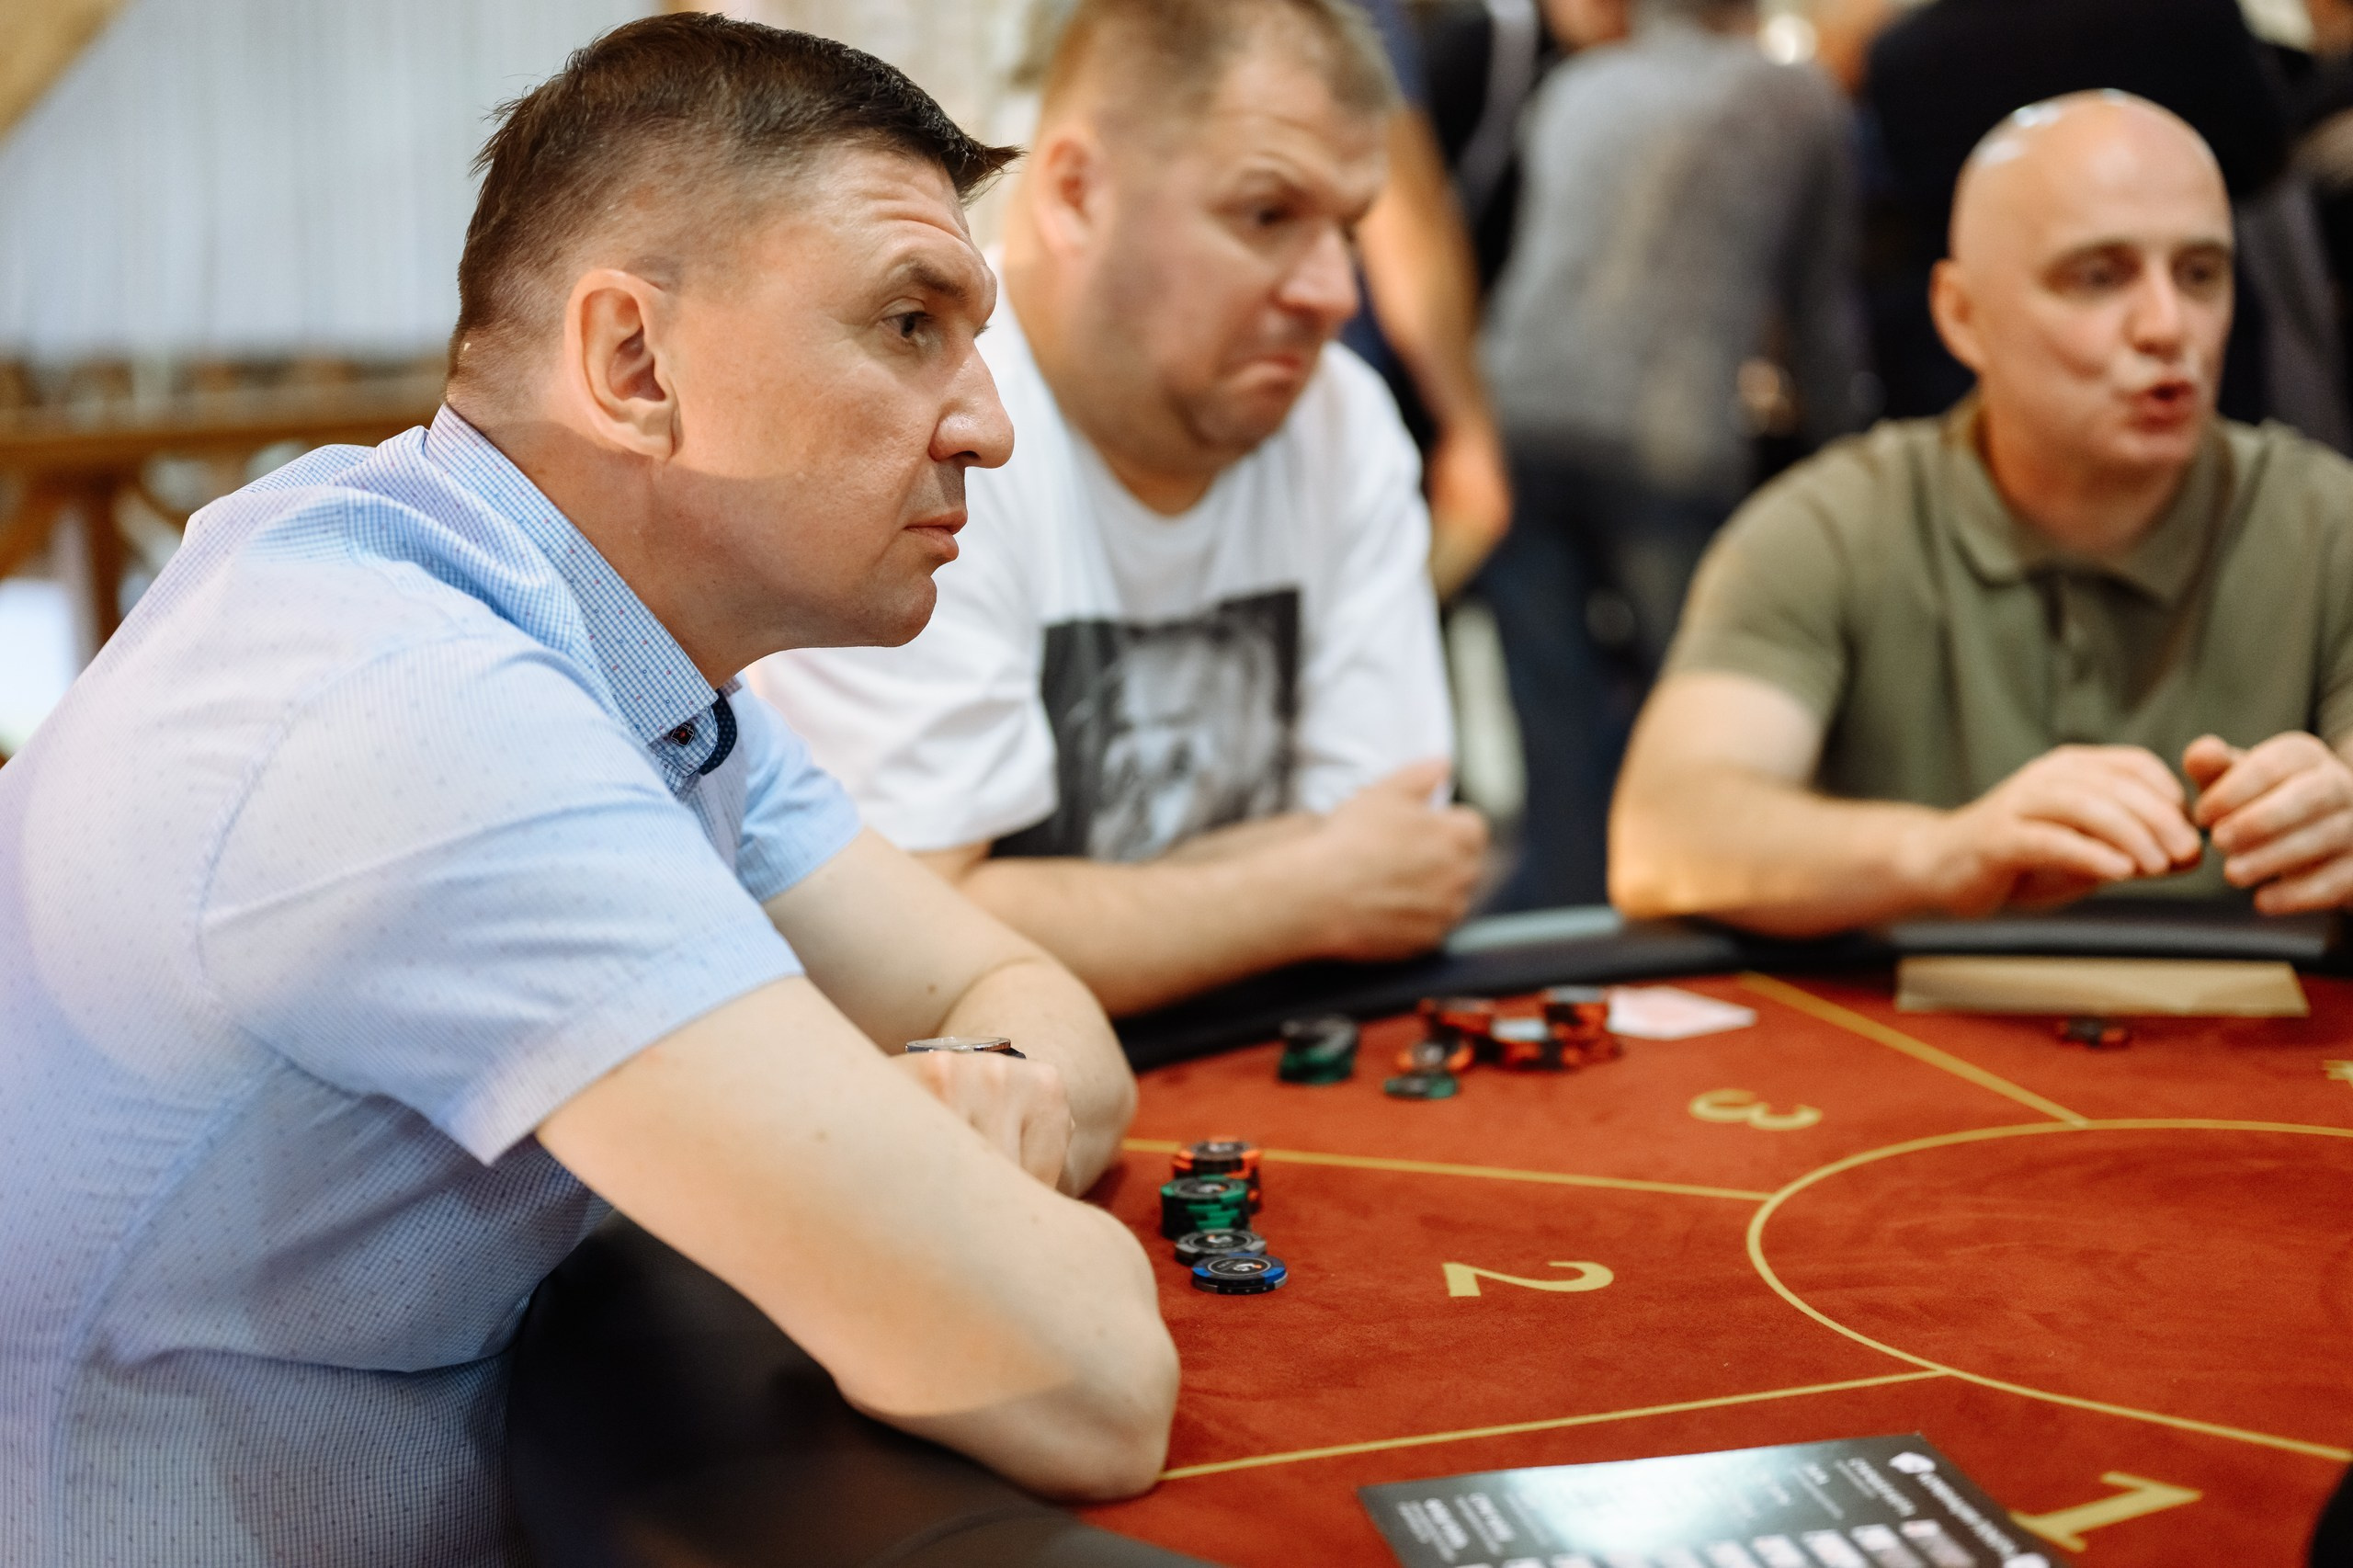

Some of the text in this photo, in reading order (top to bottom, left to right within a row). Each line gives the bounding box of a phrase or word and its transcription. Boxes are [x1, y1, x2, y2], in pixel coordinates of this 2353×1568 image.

[1688, 1088, 1823, 1131] 3
[1442, 1261, 1615, 1298] 2
[2009, 1471, 2202, 1552] 1
